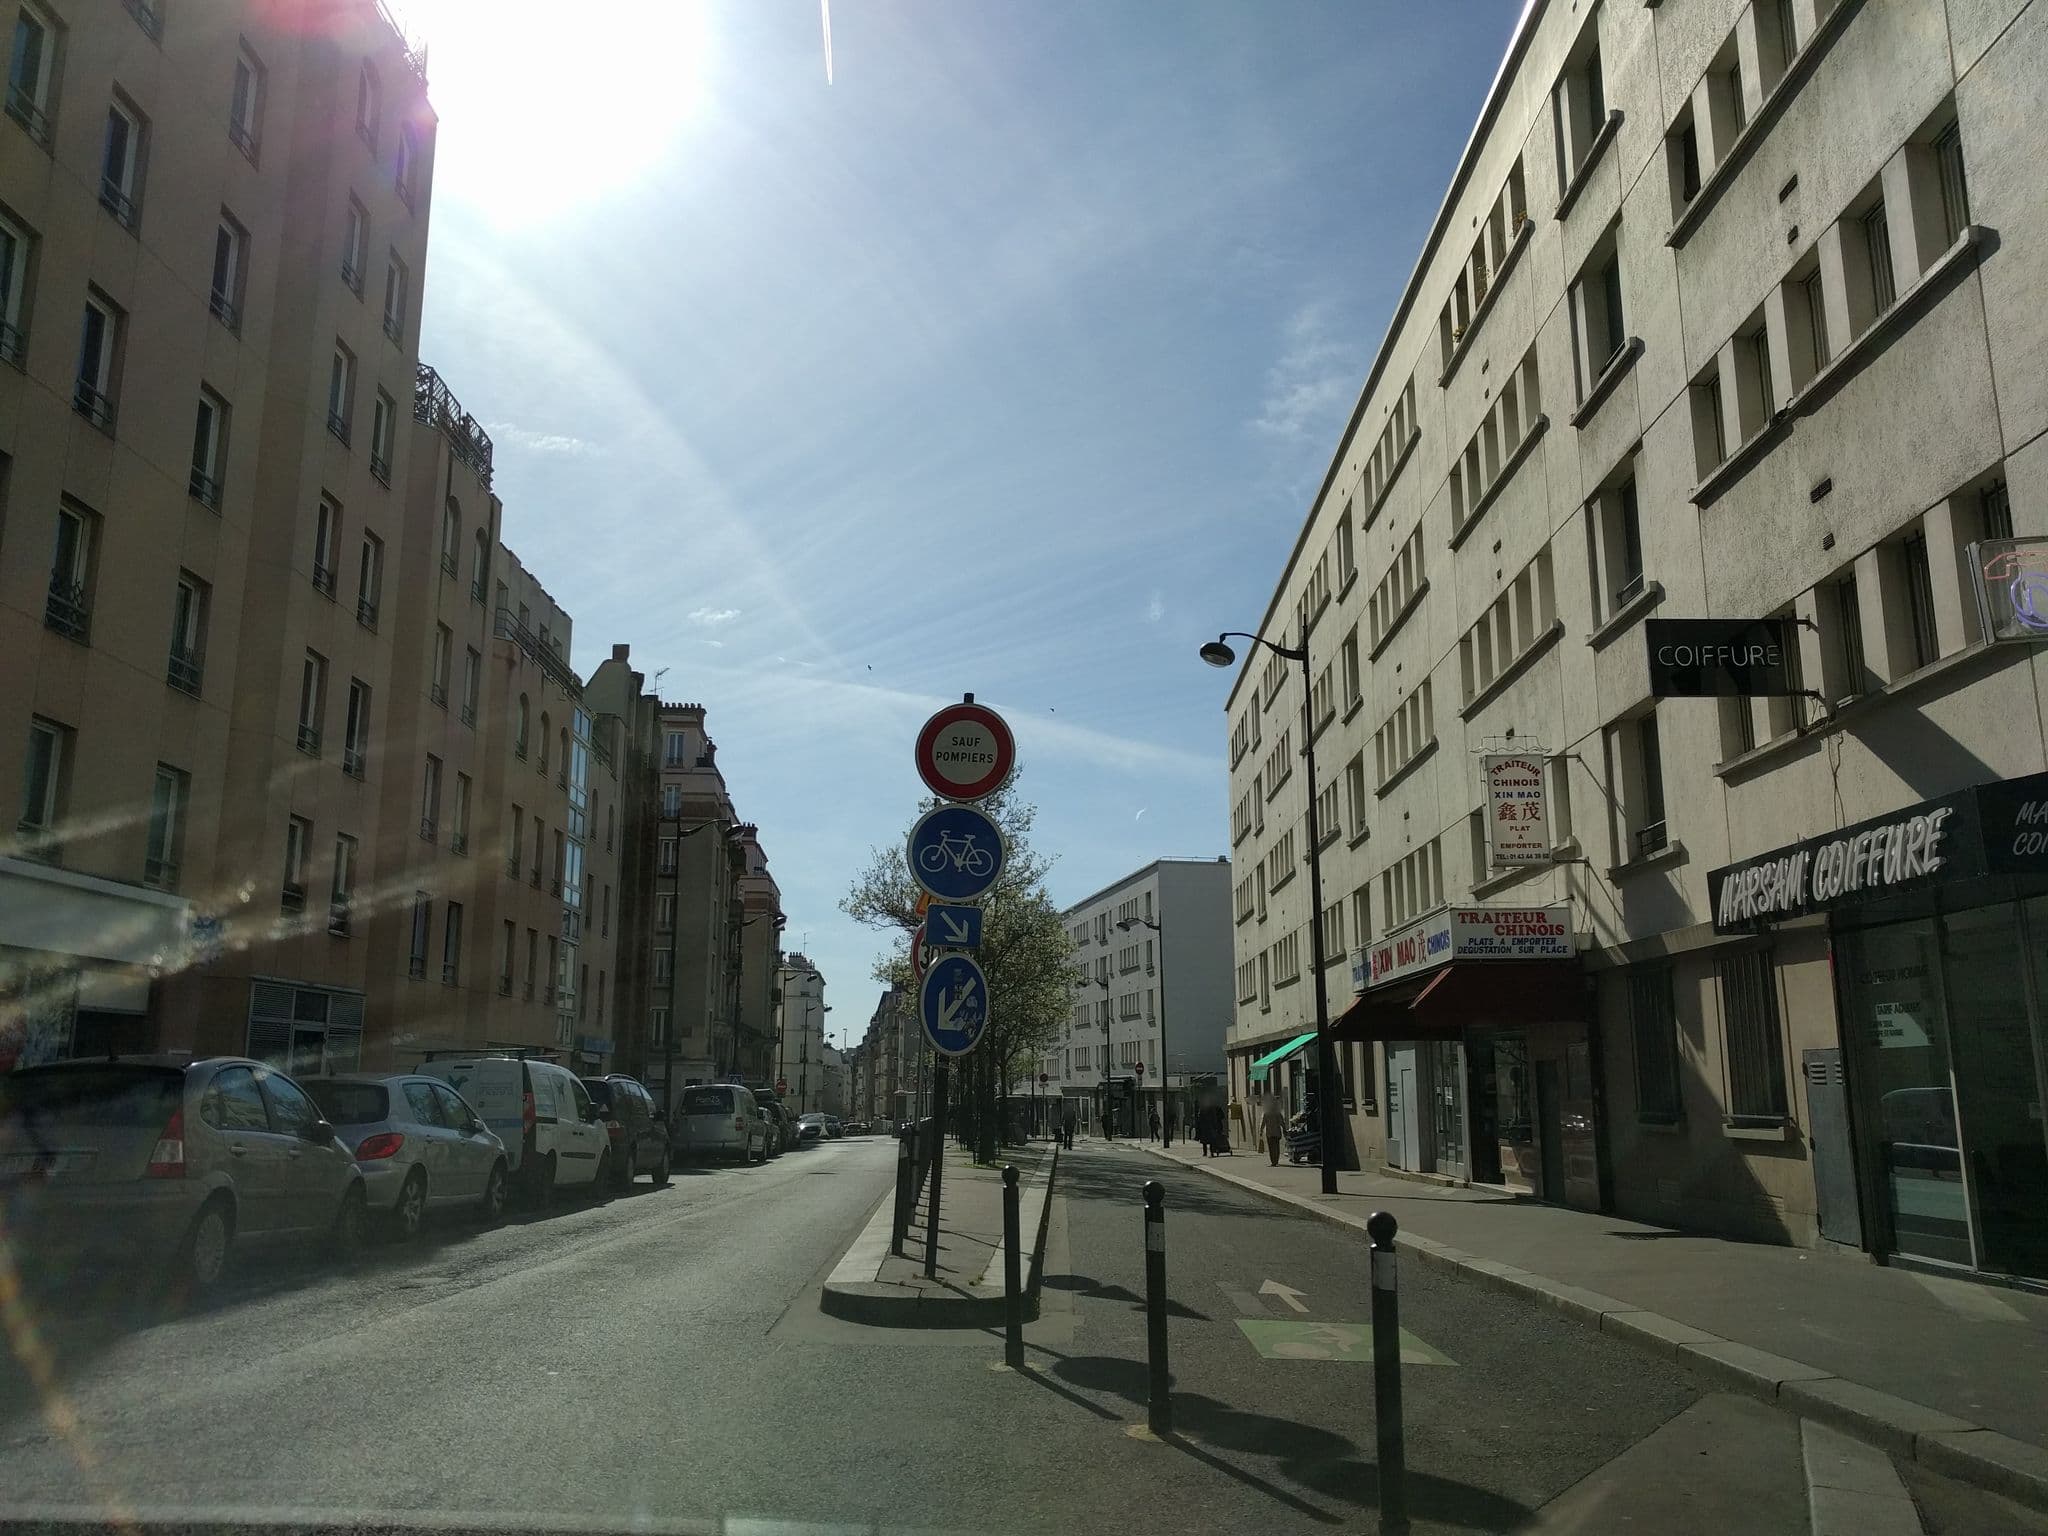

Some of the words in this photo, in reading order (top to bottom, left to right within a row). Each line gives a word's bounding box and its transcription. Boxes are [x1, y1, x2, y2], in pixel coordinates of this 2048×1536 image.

[1658, 645, 1780, 666] COIFFURE
[952, 736, 981, 747] SAUF
[936, 751, 994, 763] POMPIERS
[1490, 760, 1541, 776] TRAITEUR
[1812, 807, 1952, 901] COIFFURE
[1458, 912, 1547, 924] TRAITEUR
[1494, 924, 1565, 936] CHINOIS
[1378, 946, 1393, 975] XIN
[1396, 937, 1416, 968] MAO
[1427, 930, 1451, 956] CHINOIS
[1457, 945, 1512, 954] DEGUSTATION
[1518, 945, 1534, 954] SUR
[1540, 945, 1568, 953] PLACE
